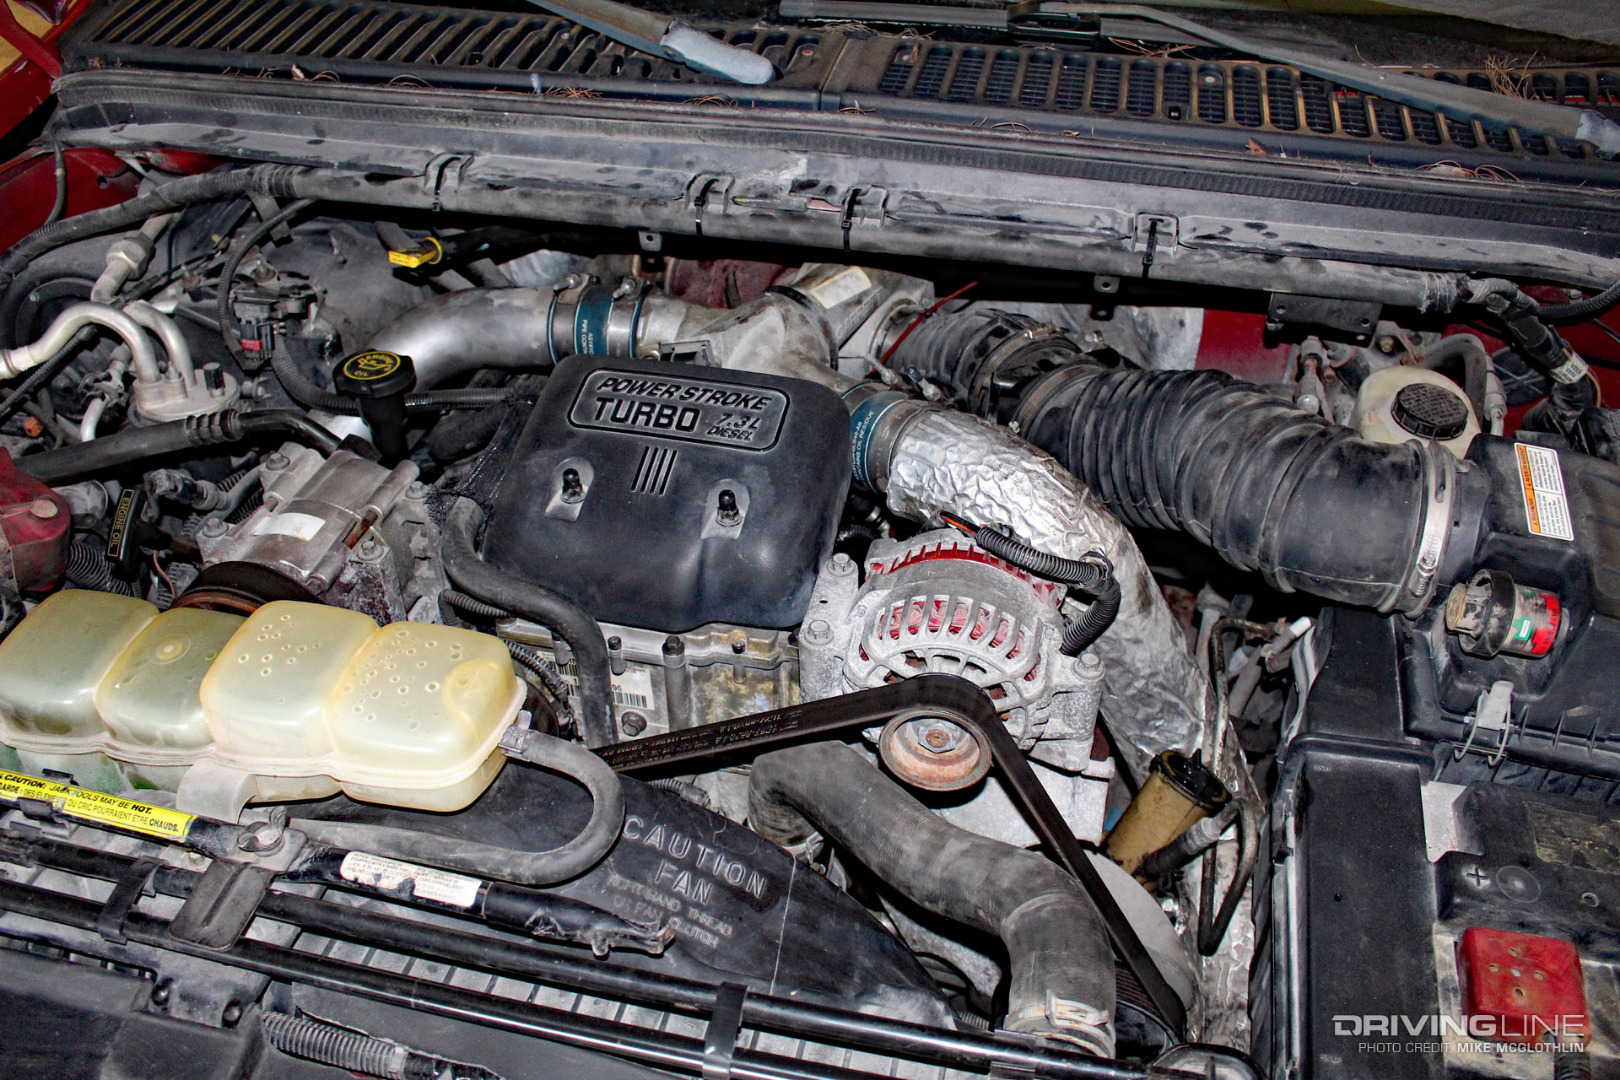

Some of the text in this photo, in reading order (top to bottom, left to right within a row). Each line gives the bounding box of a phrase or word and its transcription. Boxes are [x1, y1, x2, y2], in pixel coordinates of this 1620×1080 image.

[595, 397, 700, 432] TURBO
[597, 377, 772, 411] POWER STROKE
[706, 425, 753, 441] DIESEL
[110, 497, 131, 547] ENGINE OIL
[5, 775, 47, 789] CAUTION:
[71, 789, 99, 801] OOLS
[100, 797, 117, 805] MAY
[131, 804, 152, 814] HOT.
[68, 799, 77, 808] DU
[78, 801, 92, 811] CRIC
[93, 805, 131, 820] POURRAIENT
[149, 818, 178, 832] CHAUDS.
[622, 815, 767, 899] CAUTION
[655, 859, 713, 905] FAN
[636, 901, 664, 920] FAN
[668, 916, 719, 949] CLUTCH
[647, 887, 681, 912] HAND
[688, 906, 733, 936] THREAD
